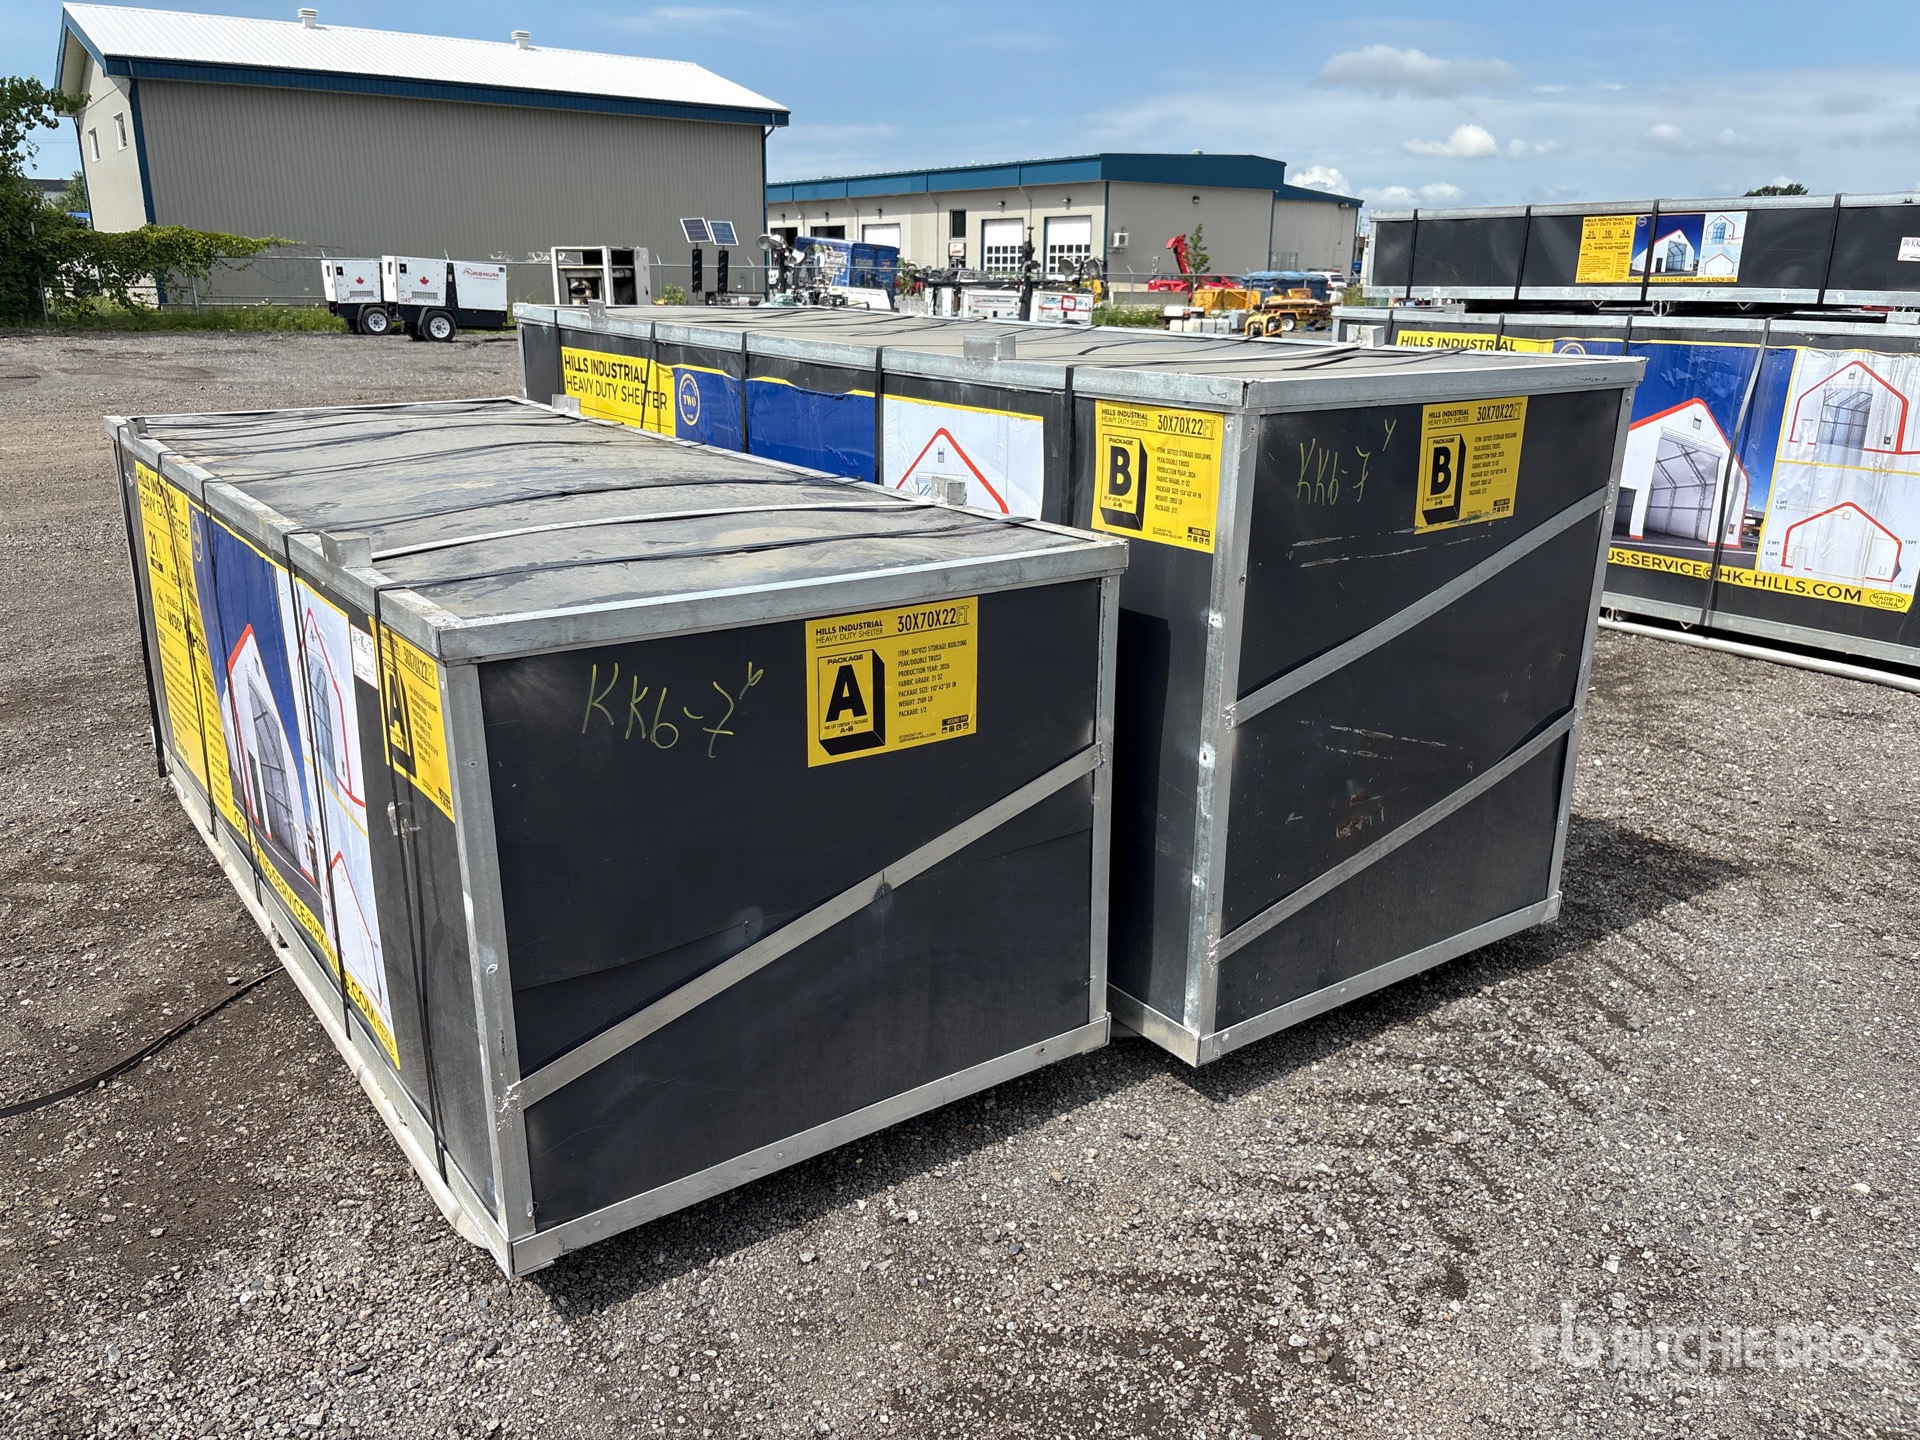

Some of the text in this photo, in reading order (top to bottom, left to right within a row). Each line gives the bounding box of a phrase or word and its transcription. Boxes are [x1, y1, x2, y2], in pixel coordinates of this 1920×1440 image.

[1400, 336, 1516, 351] HILLS INDUSTRAL
[564, 355, 646, 384] HILLS INDUSTRIAL
[566, 374, 594, 395] HEAVY
[596, 380, 618, 401] DUTY
[621, 385, 668, 411] SHELTER
[1102, 408, 1148, 420] HILLS INDUSTRIAL
[1442, 409, 1469, 418] INDUSTRIAL
[1102, 416, 1148, 427] HEAVY DUTY SHELTER
[1157, 414, 1216, 437] 30X70X22FT
[1108, 437, 1134, 446] PACKAGE
[1432, 437, 1455, 445] PACKAGE
[1108, 445, 1132, 497] B
[1430, 446, 1452, 496] B
[1873, 594, 1893, 603] MADE
[1876, 600, 1899, 608] CHINA
[897, 605, 970, 632] 30X70X22FT
[816, 620, 883, 636] HILLS INDUSTRIAL
[816, 628, 883, 644] HEAVY DUTY SHELTER
[928, 643, 947, 652] STORAGE
[947, 640, 967, 649] BUILDING
[827, 654, 864, 665] PACKAGE
[898, 654, 942, 667] PEAK/DOUBLE TRUSS
[898, 667, 926, 678] PRODUCTION
[926, 665, 939, 673] YEAR:
[898, 679, 914, 687] FABRIC
[915, 676, 930, 685] GRADE:
[825, 664, 867, 722] A
[898, 689, 918, 698] PACKAGE
[919, 686, 930, 694] SIZE:
[389, 672, 406, 736] A
[898, 699, 916, 708] WEIGHT:
[927, 695, 933, 703] LB
[898, 708, 919, 718] PACKAGE:
